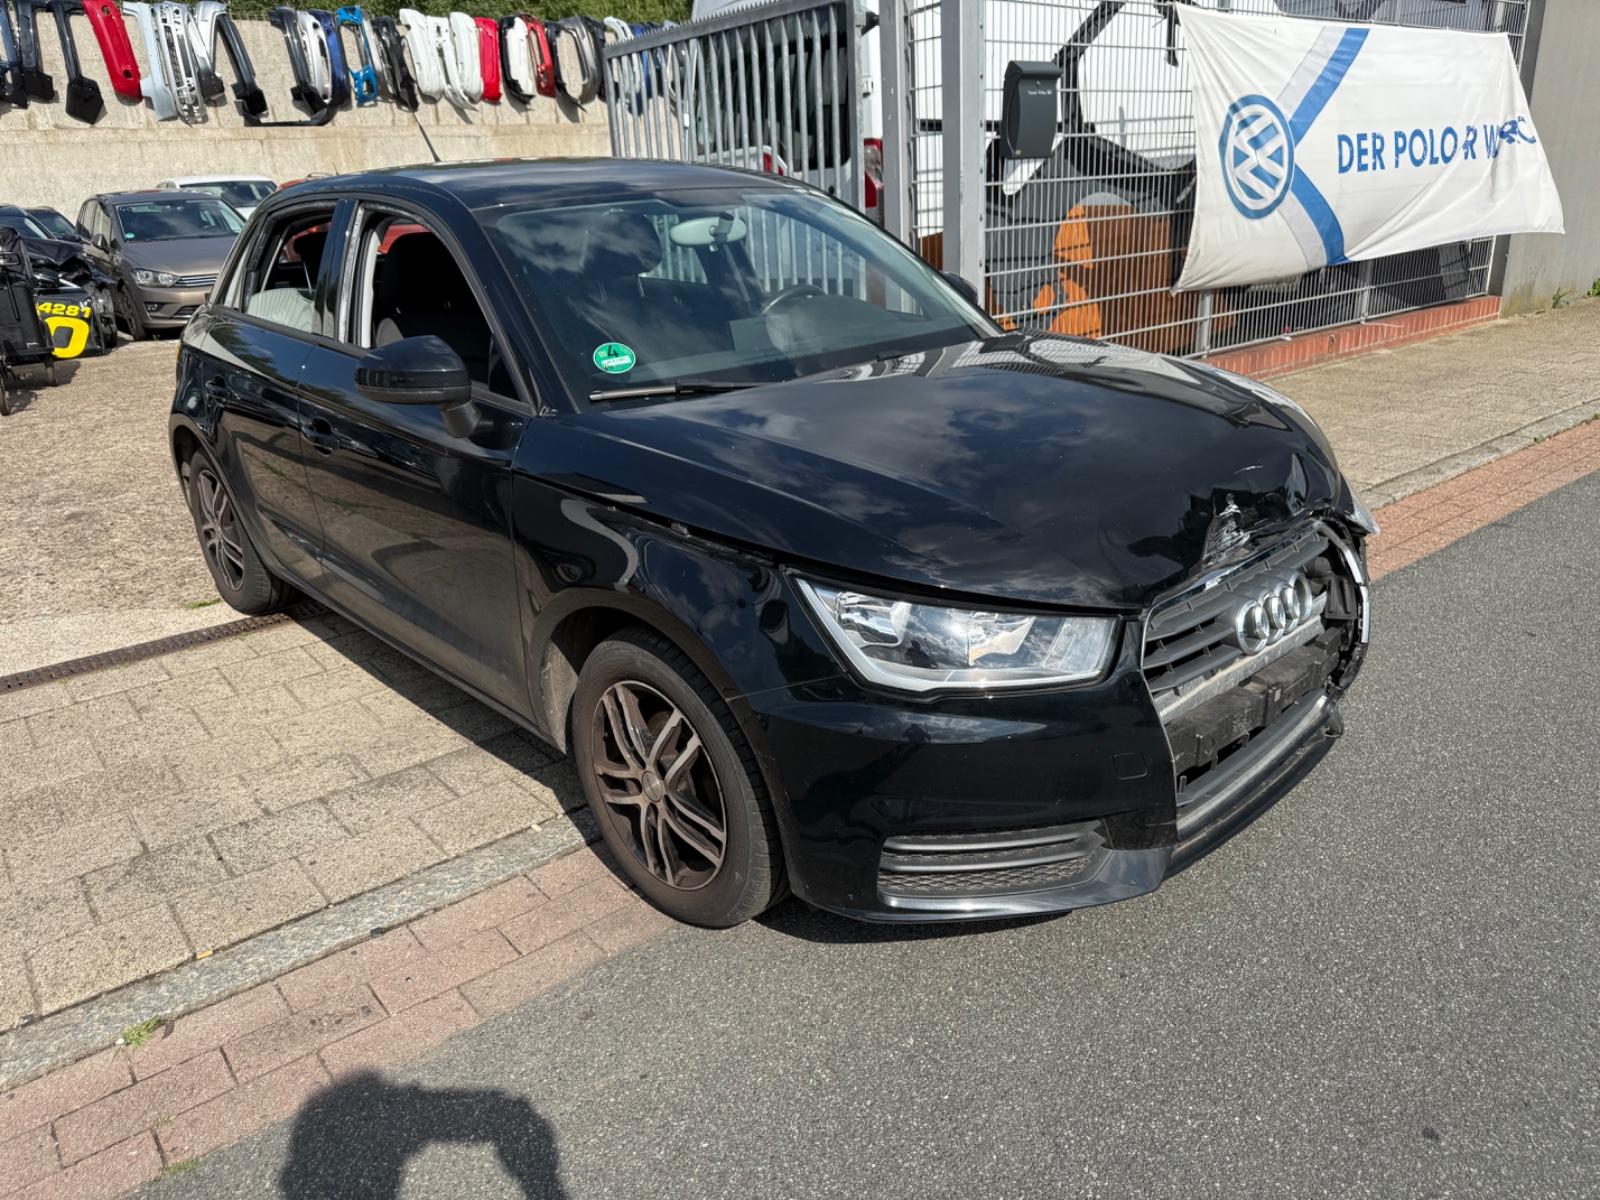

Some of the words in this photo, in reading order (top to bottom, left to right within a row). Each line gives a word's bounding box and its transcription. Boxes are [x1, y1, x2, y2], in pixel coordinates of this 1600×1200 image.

[1337, 132, 1385, 174] DER
[1394, 127, 1458, 168] POLO
[1462, 125, 1477, 160] R
